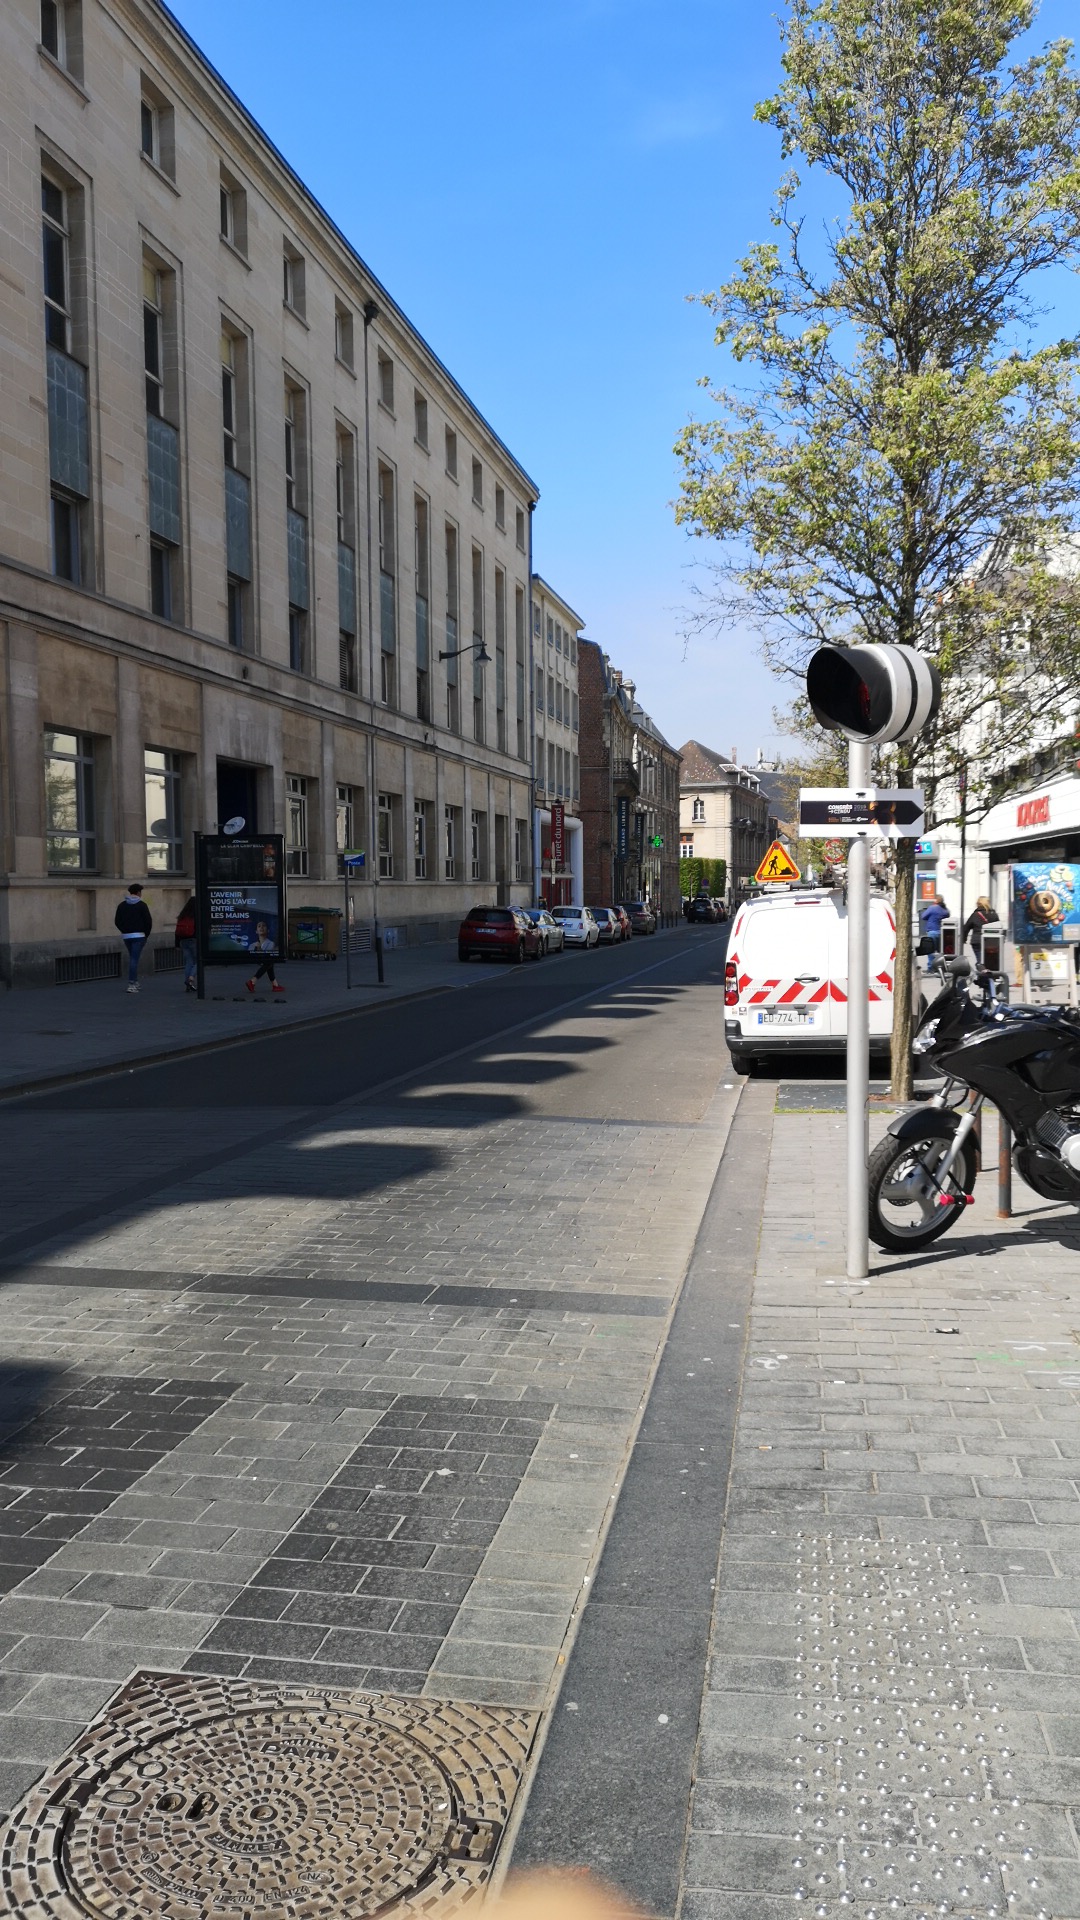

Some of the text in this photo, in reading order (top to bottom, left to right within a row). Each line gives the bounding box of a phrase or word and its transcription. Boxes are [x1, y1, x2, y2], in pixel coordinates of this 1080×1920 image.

[554, 808, 562, 862] Furet du nord
